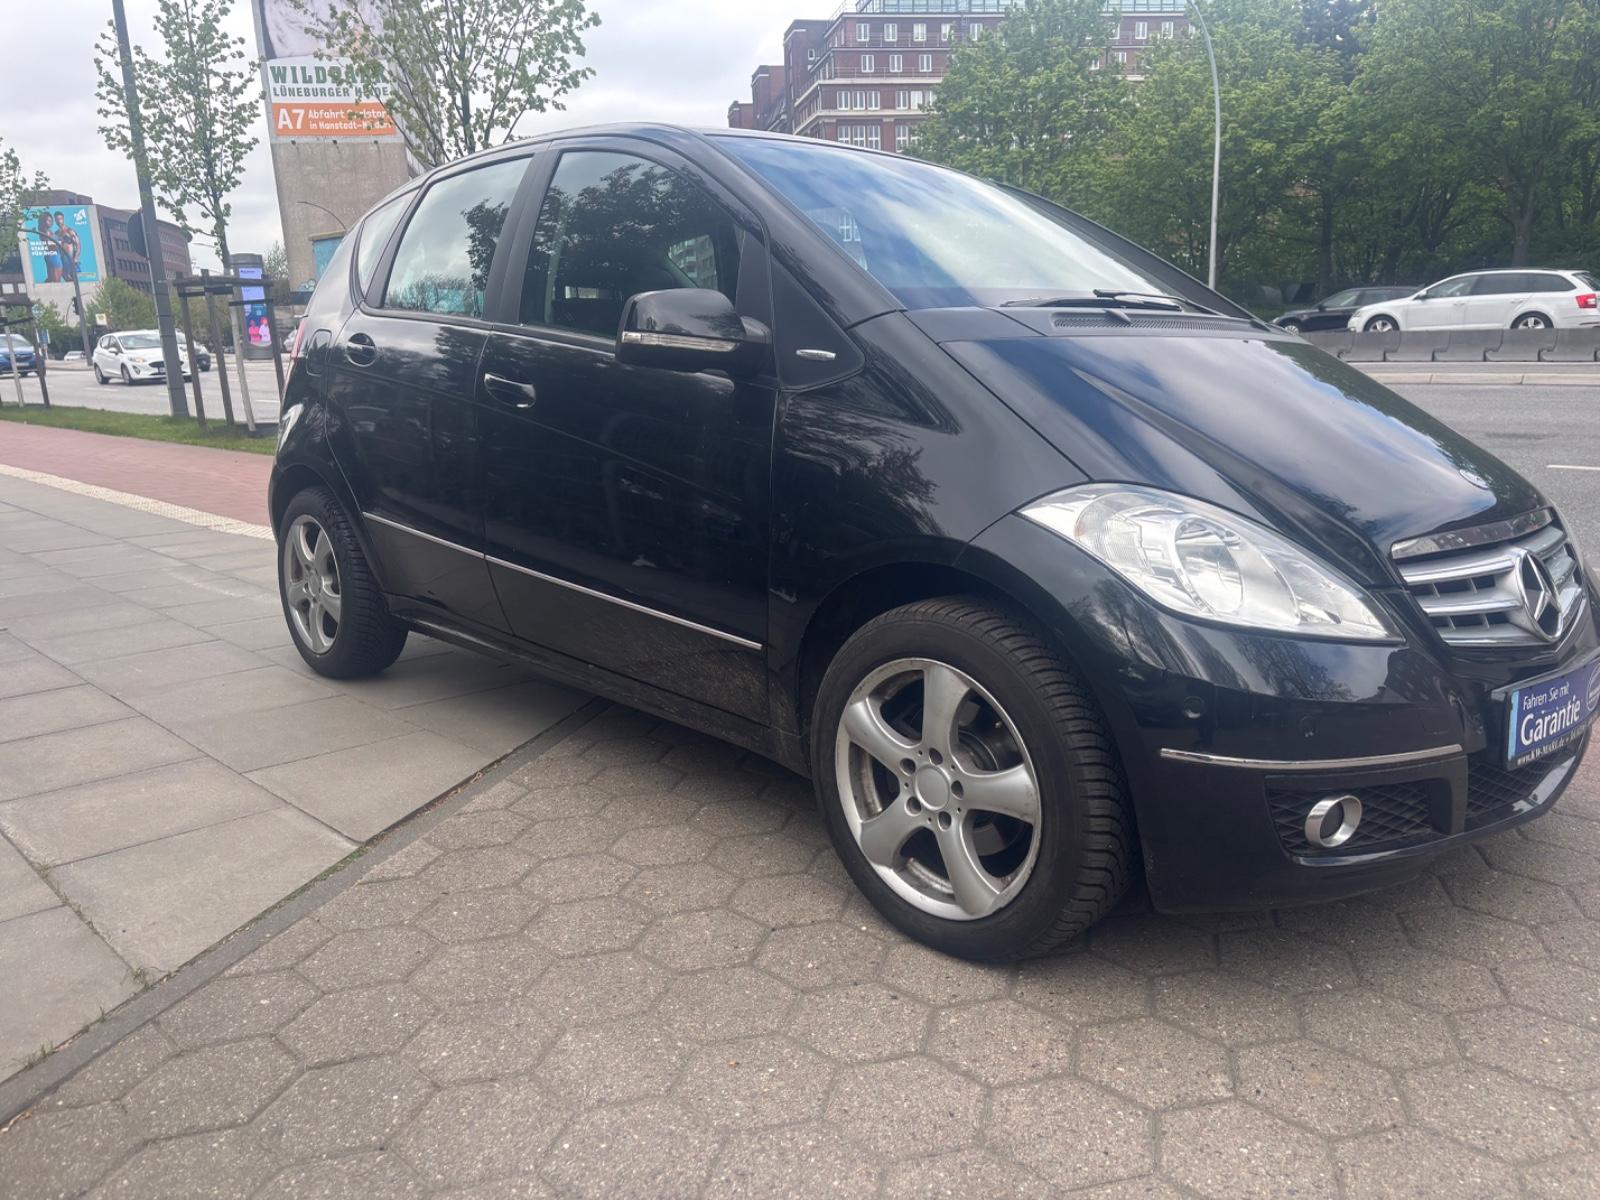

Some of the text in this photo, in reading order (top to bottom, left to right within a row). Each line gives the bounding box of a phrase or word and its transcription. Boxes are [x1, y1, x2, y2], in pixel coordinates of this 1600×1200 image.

[273, 85, 389, 97] LÜNEBURGER HDE
[277, 108, 305, 129] A7
[308, 109, 344, 119] Abfahrt
[309, 121, 317, 129] in
[1523, 693, 1547, 711] Fahren
[1549, 687, 1558, 702] Sie
[1559, 682, 1570, 698] mit
[1521, 695, 1581, 746] Garantie
